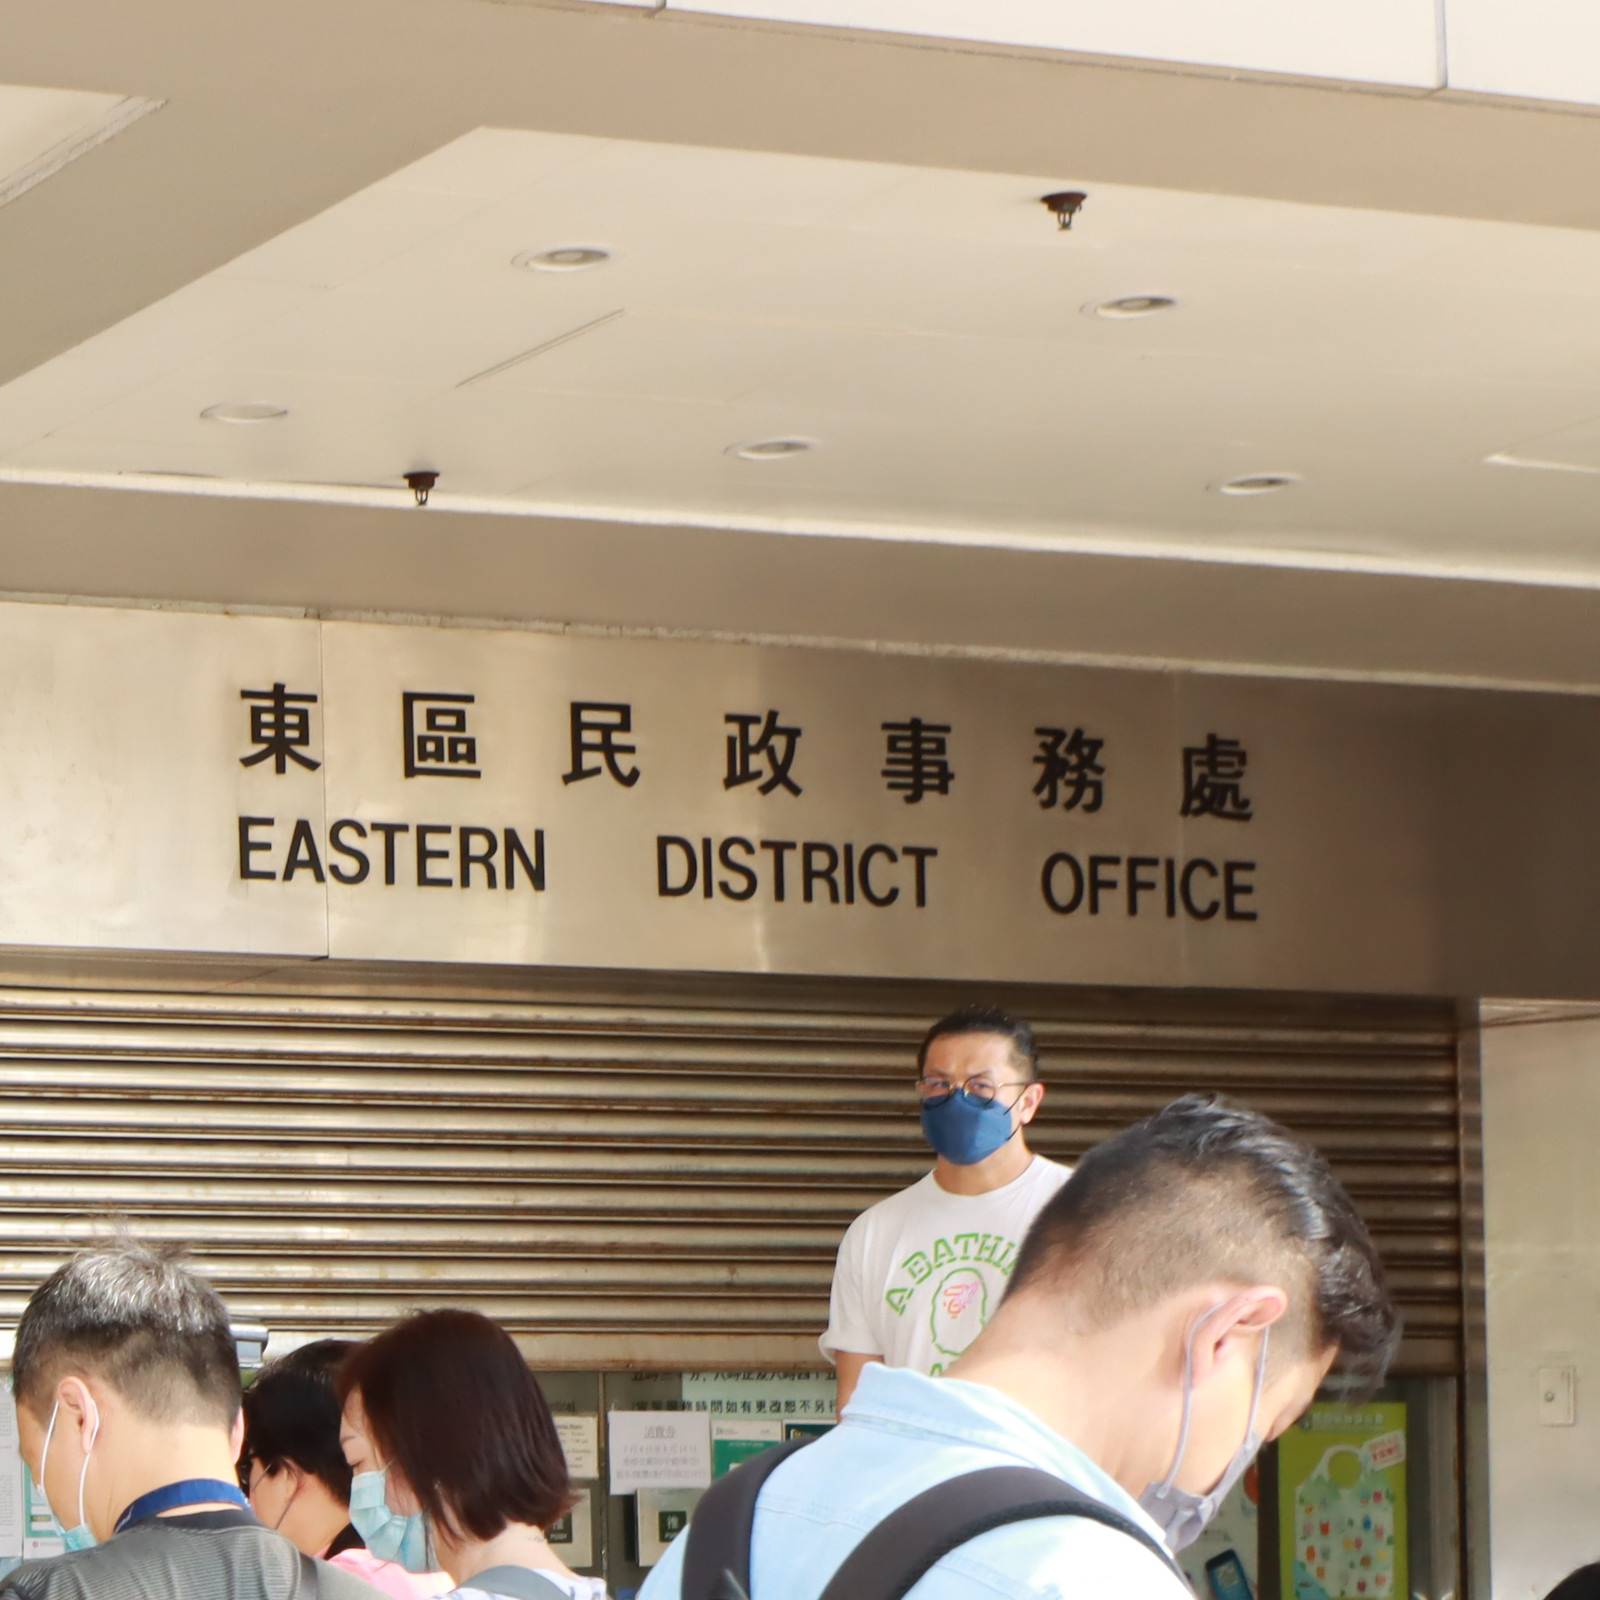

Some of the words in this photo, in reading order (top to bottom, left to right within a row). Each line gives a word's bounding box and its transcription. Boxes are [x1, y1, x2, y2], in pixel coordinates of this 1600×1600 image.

[239, 682, 1254, 823] 東區民政事務處
[237, 816, 547, 893] EASTERN
[655, 834, 939, 908] DISTRICT
[1040, 851, 1259, 922] OFFICE
[901, 1231, 1019, 1286] BATHI
